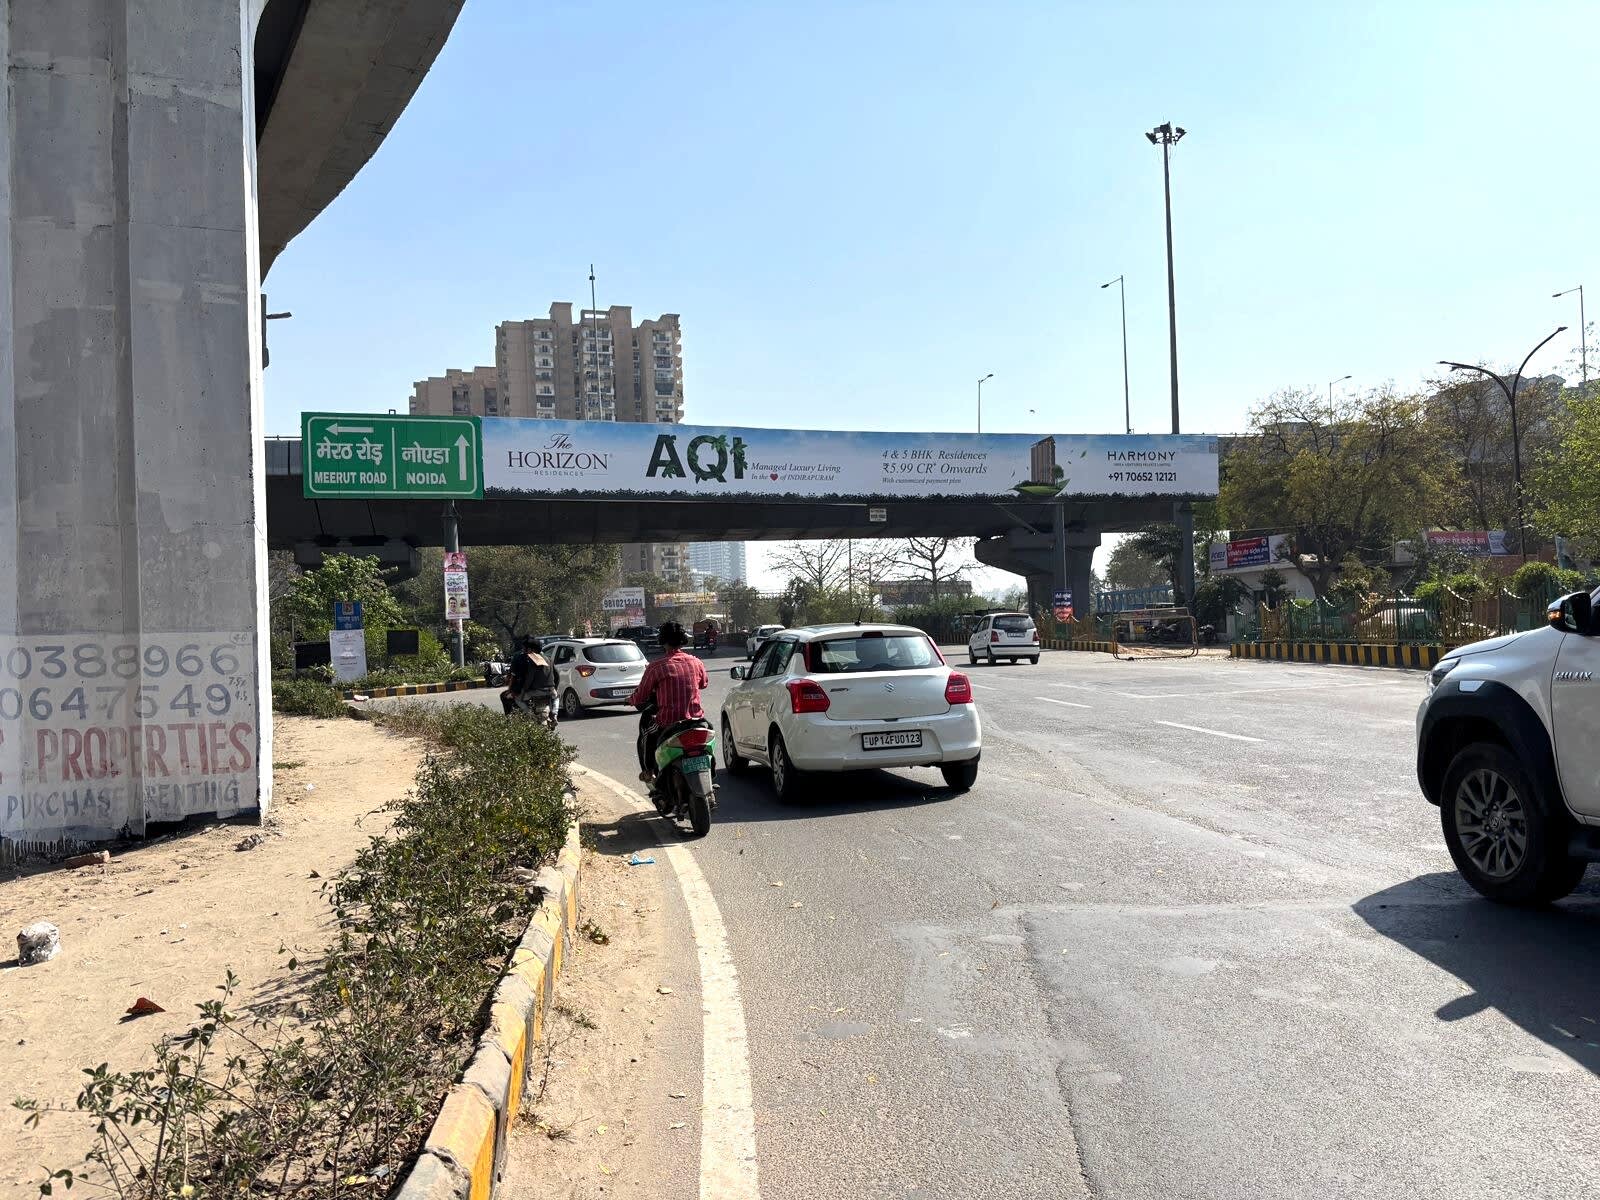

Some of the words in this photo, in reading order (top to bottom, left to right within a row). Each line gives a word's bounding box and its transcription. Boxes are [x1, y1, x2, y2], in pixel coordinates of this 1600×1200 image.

[316, 436, 353, 460] मेरठ
[543, 433, 573, 449] The
[402, 441, 450, 465] नोएडा
[646, 434, 748, 483] AQI
[882, 450, 889, 460] 4
[890, 450, 899, 460] &
[902, 449, 909, 460] 5
[910, 450, 933, 460] BHK
[938, 450, 987, 460] Residences
[1107, 451, 1176, 461] HARMONY
[507, 451, 609, 470] HORIZON
[751, 462, 787, 472] Managed
[789, 463, 816, 473] Luxury
[817, 464, 841, 473] Living
[940, 463, 987, 474] Onwards
[314, 471, 357, 484] MEERUT
[359, 472, 387, 485] ROAD
[406, 472, 447, 485] NOIDA
[1108, 472, 1123, 482] +91
[1126, 472, 1153, 482] 70652
[1155, 472, 1177, 482] 12121
[0, 643, 240, 680] 0388966
[869, 733, 920, 746] UP14FU0123
[36, 722, 253, 783] PROPERTIES
